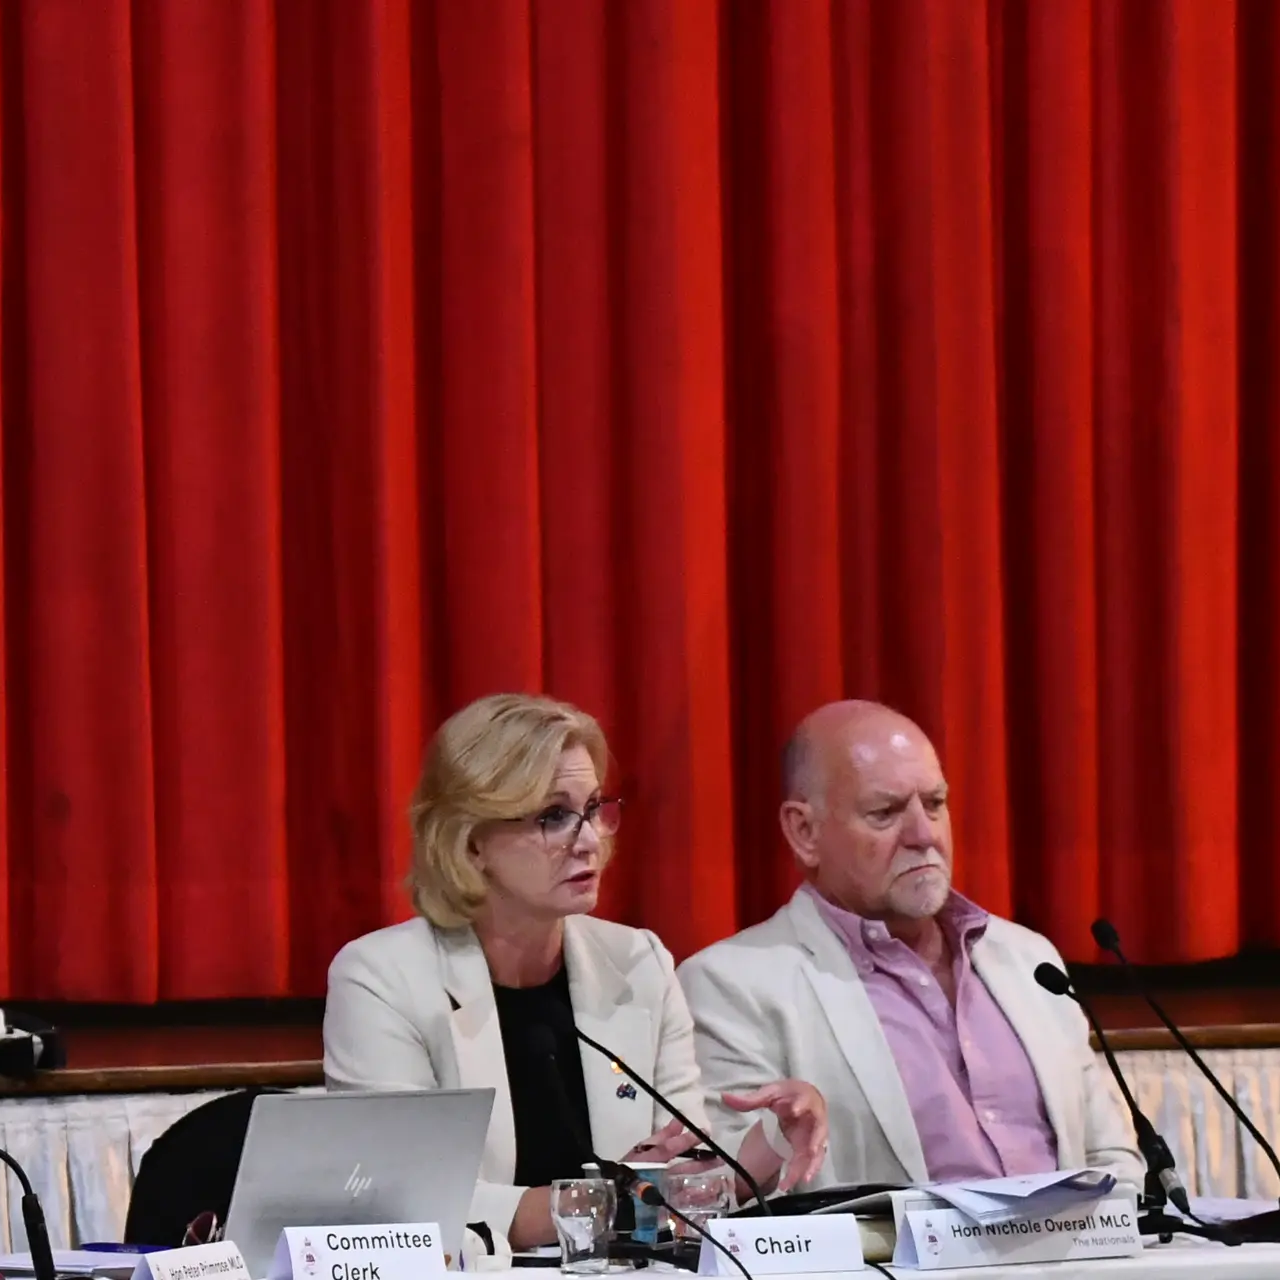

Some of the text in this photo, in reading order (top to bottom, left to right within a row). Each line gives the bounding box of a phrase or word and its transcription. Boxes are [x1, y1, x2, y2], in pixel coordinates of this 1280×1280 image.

[950, 1213, 1132, 1238] Hon Nichole Overall MLC
[326, 1230, 433, 1251] Committee
[754, 1234, 812, 1255] Chair
[1091, 1234, 1137, 1246] Nationals
[183, 1265, 201, 1279] Peter
[227, 1255, 245, 1271] MLC
